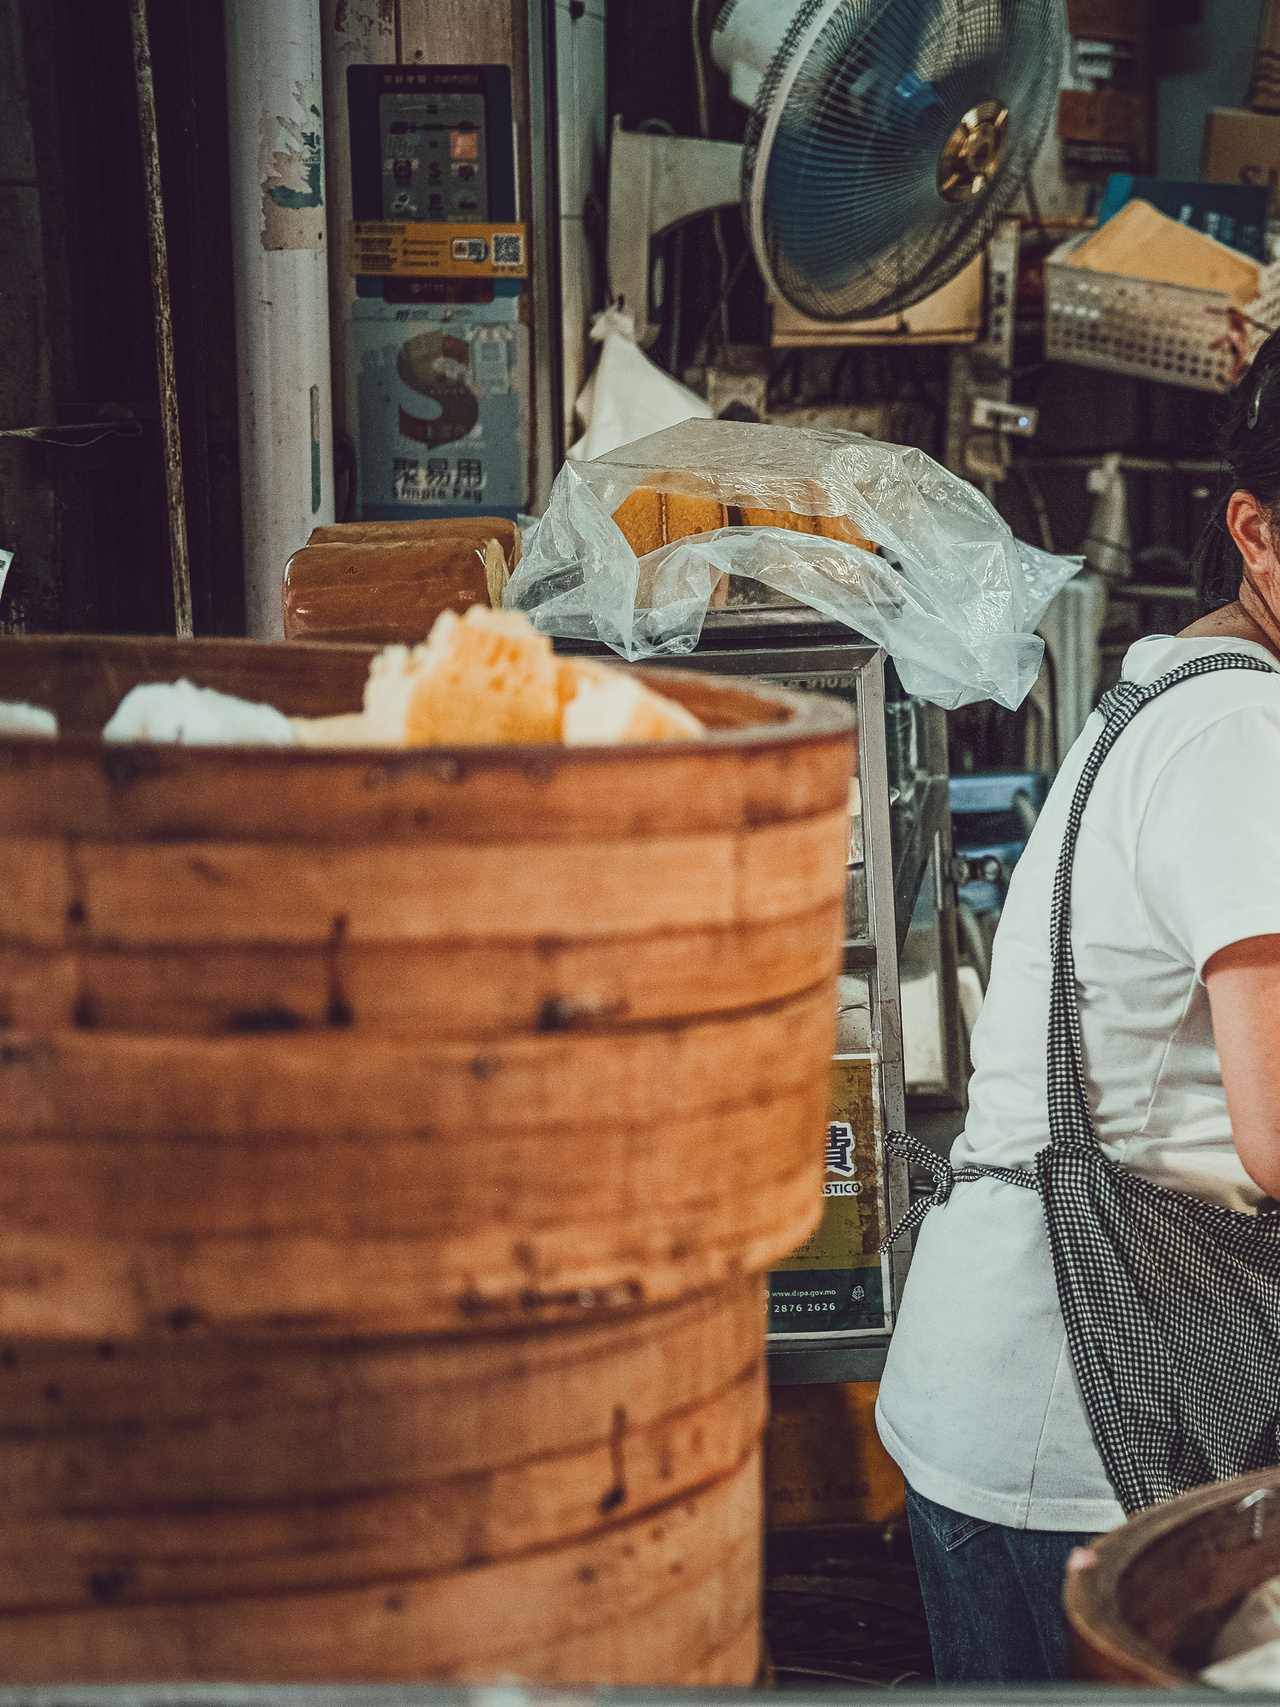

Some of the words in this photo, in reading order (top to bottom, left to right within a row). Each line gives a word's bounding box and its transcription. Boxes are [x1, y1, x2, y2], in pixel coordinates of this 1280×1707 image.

[822, 1184, 860, 1194] STICO
[774, 1304, 802, 1313] 2876
[807, 1303, 836, 1312] 2626
